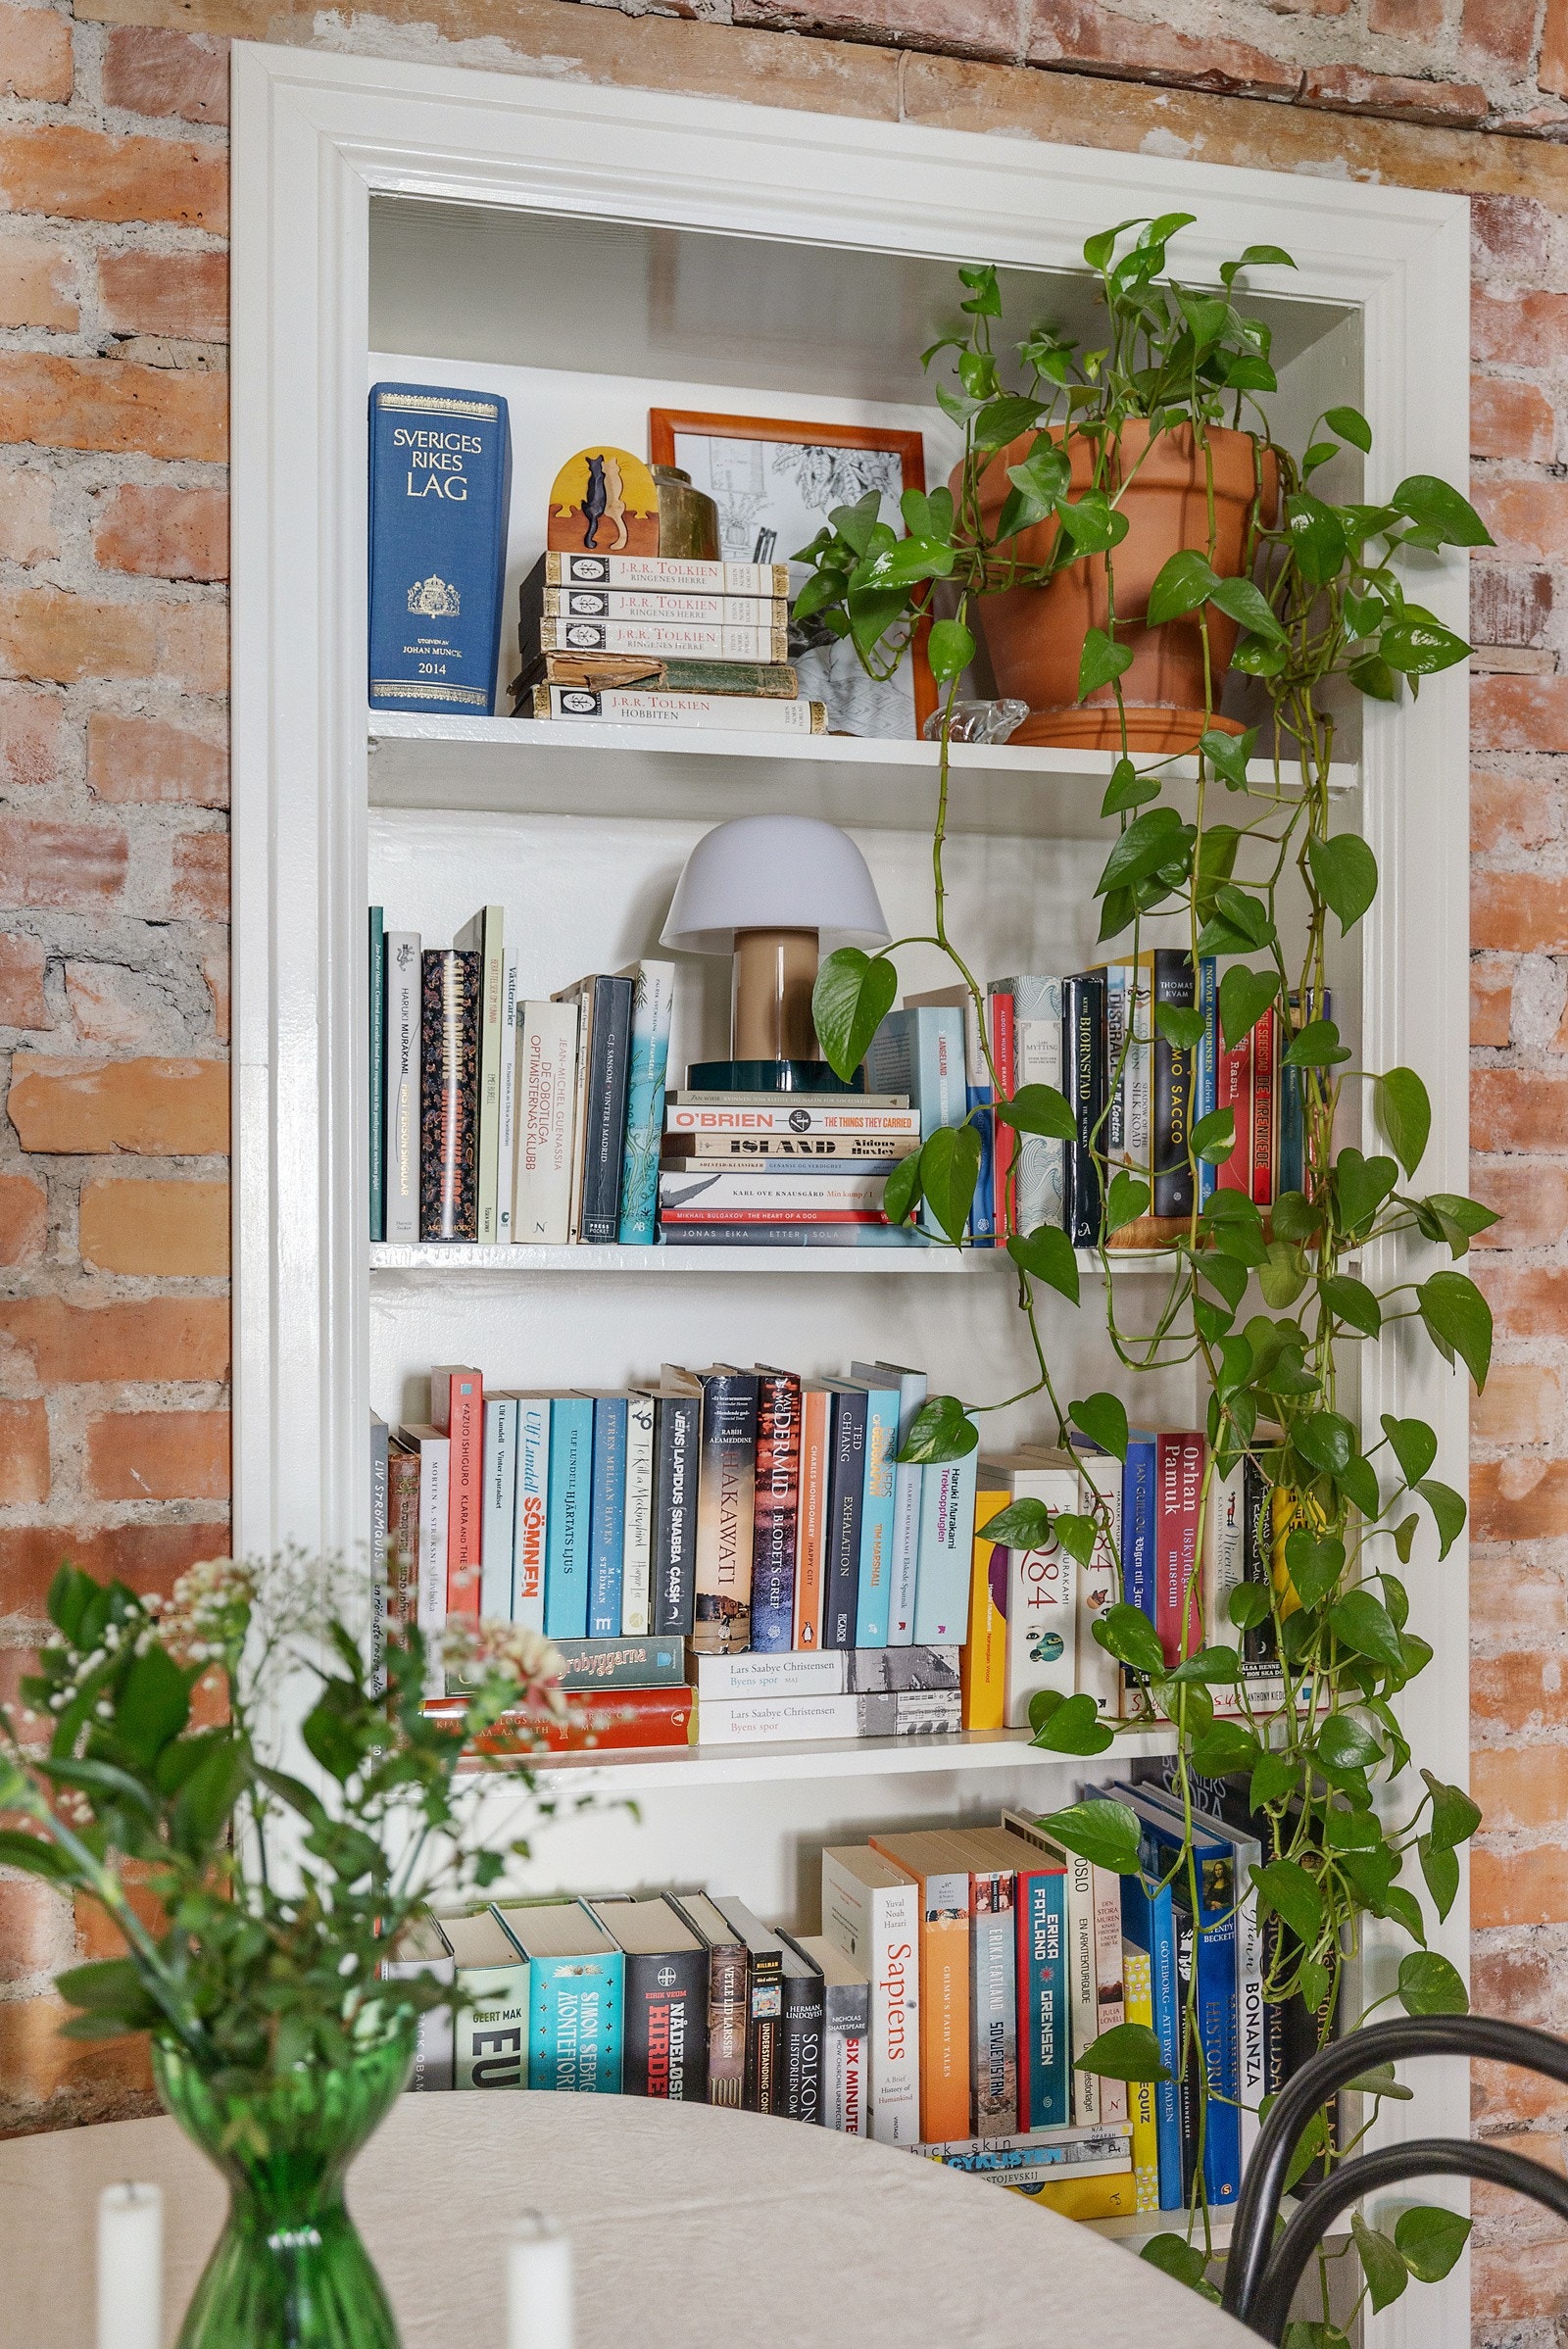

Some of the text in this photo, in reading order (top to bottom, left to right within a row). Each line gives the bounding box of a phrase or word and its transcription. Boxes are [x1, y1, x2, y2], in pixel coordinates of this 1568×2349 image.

[393, 428, 482, 454] SVERIGES
[412, 451, 463, 471] RIKES
[406, 472, 468, 501] LAG
[620, 562, 718, 576] J.R.R. TOLKIEN
[677, 576, 707, 585] HERRE
[619, 596, 717, 611] J.R.R. TOLKIEN
[630, 609, 707, 618] RINGENES HERRE
[402, 646, 463, 658] JOHAN MUNCK
[617, 627, 716, 642] J.R.R. TOLKIEN
[627, 640, 705, 651] RINGENES HERRE
[418, 662, 446, 675] 2014
[612, 696, 710, 711] J.R.R. TOLKIEN
[621, 710, 679, 720] HOBBITEN
[506, 967, 517, 1027] Växtterrarier
[401, 988, 410, 1075] HARUKI MURAKAMI
[606, 1050, 614, 1083] SANSOM
[1079, 1016, 1092, 1101] BJØRNSTAD
[1229, 1061, 1240, 1099] Rasul
[1255, 1011, 1271, 1169] SNE SEIERSTAD DE KRENKEDE
[525, 1035, 541, 1171] OPTIMISTERNAS KLUBB
[538, 1062, 552, 1146] DE OBOTLIGA
[554, 1038, 567, 1171] JEAN-MICHEL GUENASSIA
[603, 1091, 612, 1122] VINTER
[675, 1112, 912, 1128] O'BRIEN THE THINGS THEY CARRIED
[1132, 1082, 1142, 1148] SILK ROAD
[1171, 1085, 1183, 1144] SACCO
[601, 1128, 610, 1162] MADRID
[730, 1140, 836, 1153] ISLAND
[851, 1147, 896, 1156] Huxley
[775, 1189, 824, 1198] KNAUSGÅRD
[842, 1191, 863, 1199] kamp
[840, 1411, 853, 1462] CHIANG
[853, 1424, 863, 1450] TED
[605, 1413, 616, 1545] FYREN MELLAN HAVEN
[809, 1445, 818, 1479] CHARLES
[882, 1427, 896, 1497] PRISONERS
[1165, 1444, 1181, 1516] Pamuk
[1183, 1446, 1200, 1512] Orhan
[521, 1411, 546, 1598] Ulf Lundell SÖMNEN
[563, 1430, 578, 1575] ULF LUNDELL HJÄRTATS LJUS
[668, 1411, 686, 1603] JENS LAPIDUS SNABBA CASH
[717, 1452, 740, 1586] HAKAWATI
[808, 1481, 817, 1538] MONTGOMERY
[937, 1468, 951, 1542] Trekkoppfuglen
[947, 1468, 960, 1549] Haruki Murakami
[840, 1495, 854, 1577] EXHALATION
[871, 1523, 883, 1588] TIM MARSHALL
[1224, 1526, 1241, 1591] Niceville
[599, 1556, 608, 1603] STEDMAN
[1061, 1548, 1070, 1605] MURAKAMI
[1168, 1550, 1178, 1608] museum
[730, 1662, 835, 1675] Lars Saabye Christensen
[730, 1707, 835, 1720] Lars Saabye Christensen
[731, 1723, 779, 1734] Byens spor
[885, 1899, 905, 1908] Yuval
[886, 1909, 905, 1918] Noah
[884, 1919, 906, 1929] Harari
[1034, 1888, 1047, 1961] FATLAND
[1047, 1914, 1058, 1959] ERIKA
[1074, 1857, 1091, 2004] OSLO EN ARKITEKTURGUIDE
[472, 2008, 522, 2024] GEERT MAK
[722, 1966, 735, 2059] VETLE LID LARSSEN
[786, 2010, 823, 2020] LINDQVIST
[790, 2004, 820, 2013] HERMAN
[832, 2015, 862, 2024] NICHOLAS
[879, 1943, 911, 2060] Sapiens
[989, 1929, 1004, 2097] ERIKA FATLAND SOVJETISTAN
[1100, 2016, 1123, 2025] LOVELL
[578, 1991, 600, 2092] SIMON SEBAG
[828, 2023, 866, 2031] SHAKESPEARE
[1041, 1989, 1054, 2066] GRENSEN
[1246, 1982, 1261, 2088] BONANZA
[760, 2023, 770, 2089] UNDERSTANDING
[789, 2033, 800, 2114] HISTORIEN OM
[710, 2077, 743, 2107] 1001
[878, 2093, 913, 2104] Humankind
[947, 2148, 1062, 2171] CYKLISTEN
[971, 2137, 1011, 2153] skin
